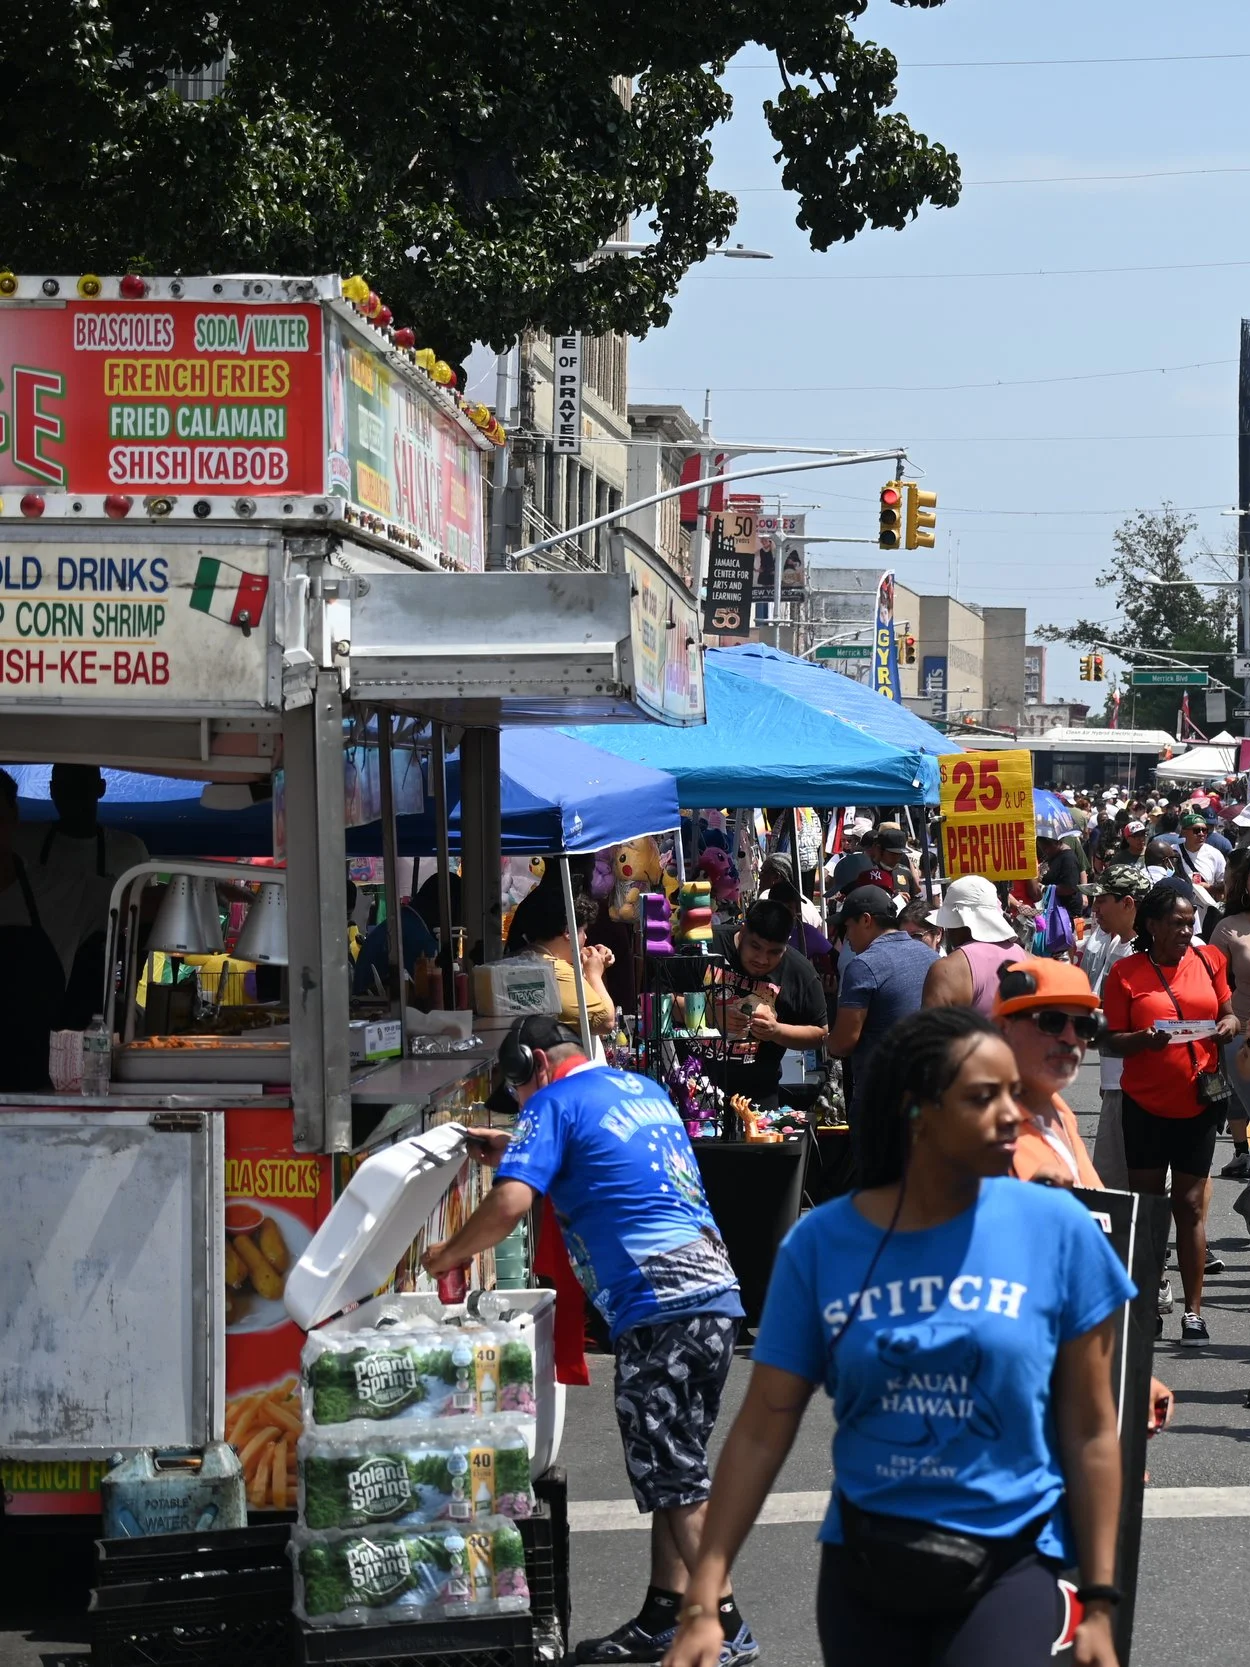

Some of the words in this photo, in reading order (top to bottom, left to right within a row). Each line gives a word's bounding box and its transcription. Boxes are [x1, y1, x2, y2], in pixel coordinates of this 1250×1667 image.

[75, 317, 173, 349] BRASCIOLES
[195, 317, 308, 352] SODA/WATER
[559, 357, 577, 368] OF
[107, 363, 206, 393] FRENCH
[215, 363, 287, 395] FRIES
[110, 406, 170, 437] FRIED
[176, 407, 285, 438] CALAMARI
[559, 375, 577, 447] PRAYER
[112, 450, 188, 481] SHISH
[198, 451, 285, 482] KABOB
[733, 516, 753, 537] 50
[57, 557, 169, 593] DRINKS
[713, 568, 736, 579] CENTER
[737, 569, 749, 580] FOR
[714, 558, 740, 568] JAMAICA
[712, 580, 728, 590] ARTS
[728, 581, 743, 591] AND
[712, 591, 742, 602] LEARNING
[16, 601, 84, 637] CORN
[92, 603, 165, 638] SHRIMP
[836, 648, 862, 657] Merrick
[876, 629, 894, 700] GYRO
[1152, 674, 1174, 683] Merrick
[1175, 674, 1189, 683] Blvd
[1004, 792, 1012, 809] &
[1013, 791, 1026, 808] UP
[946, 821, 1028, 875] PERFUME
[259, 1163, 319, 1193] STICKS
[823, 1274, 1028, 1336] STITCH
[353, 1351, 415, 1382] Poland
[476, 1349, 496, 1361] 40
[357, 1367, 419, 1401] Spring
[886, 1373, 968, 1394] KAUAI
[881, 1395, 975, 1419] HAWAII
[347, 1460, 409, 1487] Poland
[472, 1453, 492, 1468] 40
[3, 1462, 81, 1490] FRENCH
[145, 1498, 189, 1511] POTABLE
[350, 1479, 412, 1511] Spring
[145, 1514, 192, 1530] WATER
[347, 1538, 409, 1568] Poland
[468, 1536, 491, 1549] 40
[350, 1555, 412, 1589] Spring
